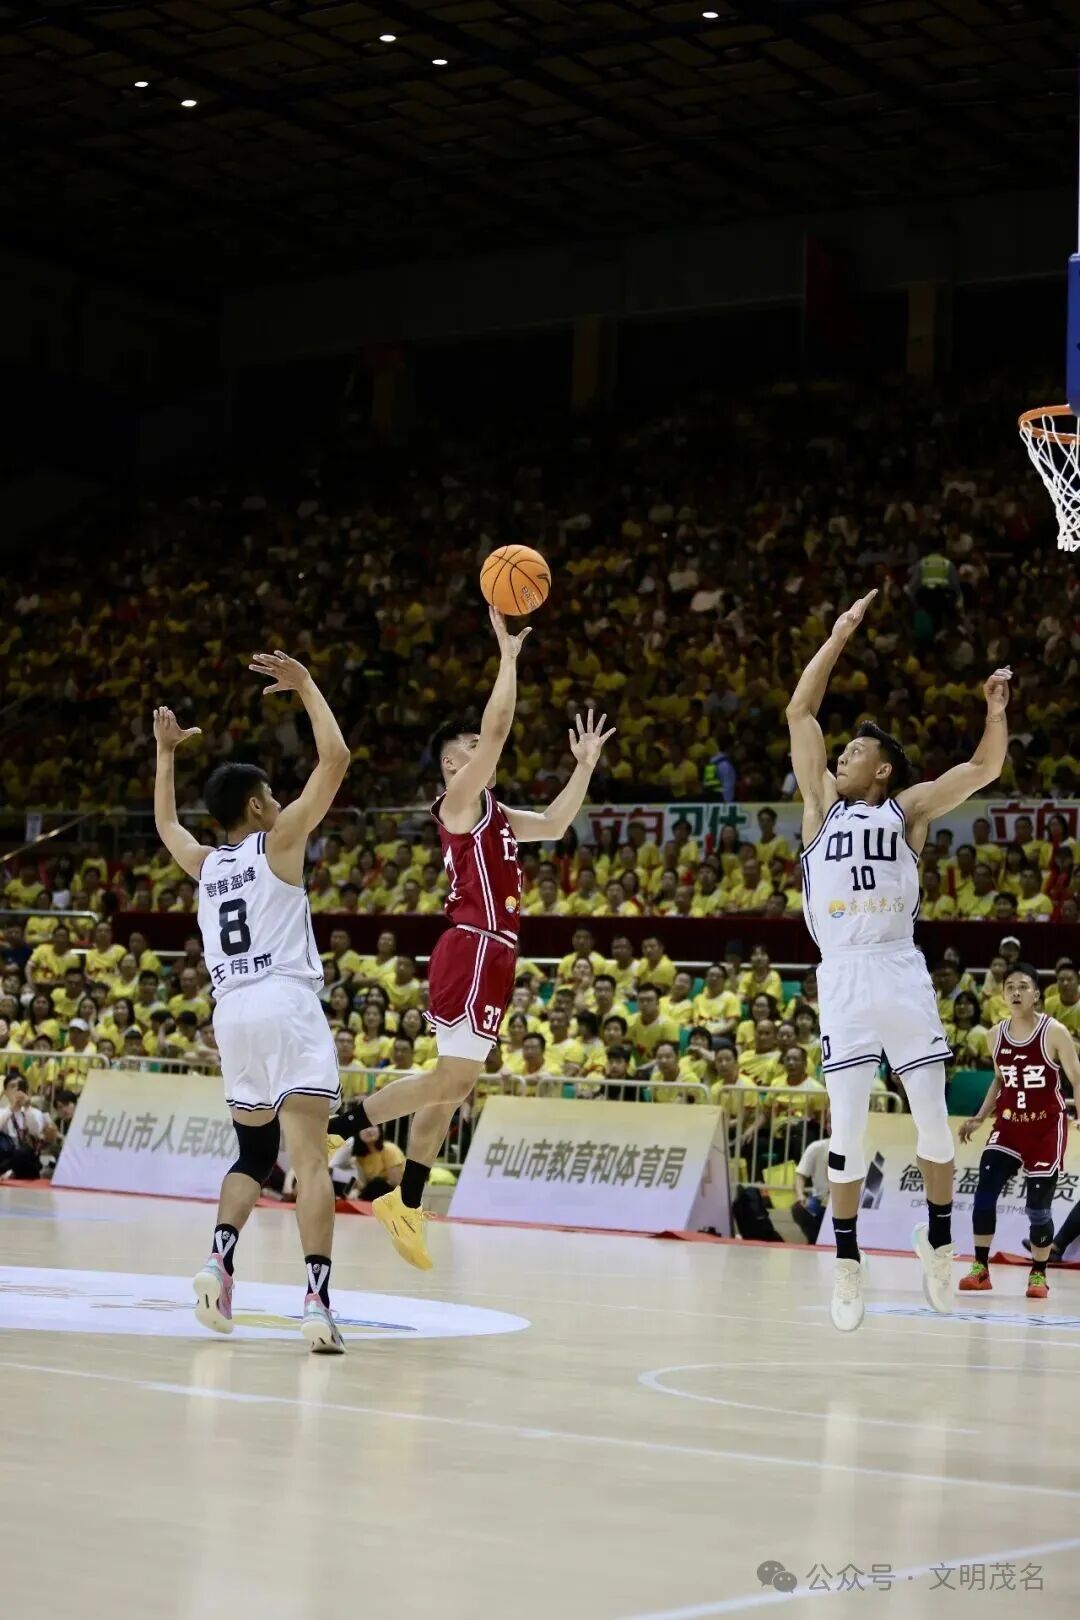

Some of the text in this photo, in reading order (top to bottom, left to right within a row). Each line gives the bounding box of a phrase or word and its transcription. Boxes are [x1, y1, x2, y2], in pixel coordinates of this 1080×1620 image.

[825, 828, 898, 862] 中山
[851, 865, 876, 891] 10
[219, 898, 251, 956] 8
[211, 953, 272, 984] 王伟成
[483, 1004, 502, 1032] 37
[999, 1065, 1046, 1089] 茂名
[1017, 1091, 1027, 1109] 2
[82, 1109, 241, 1158] 中山市人民政
[988, 1131, 1001, 1144] 2
[484, 1137, 687, 1189] 中山市教育和体育局
